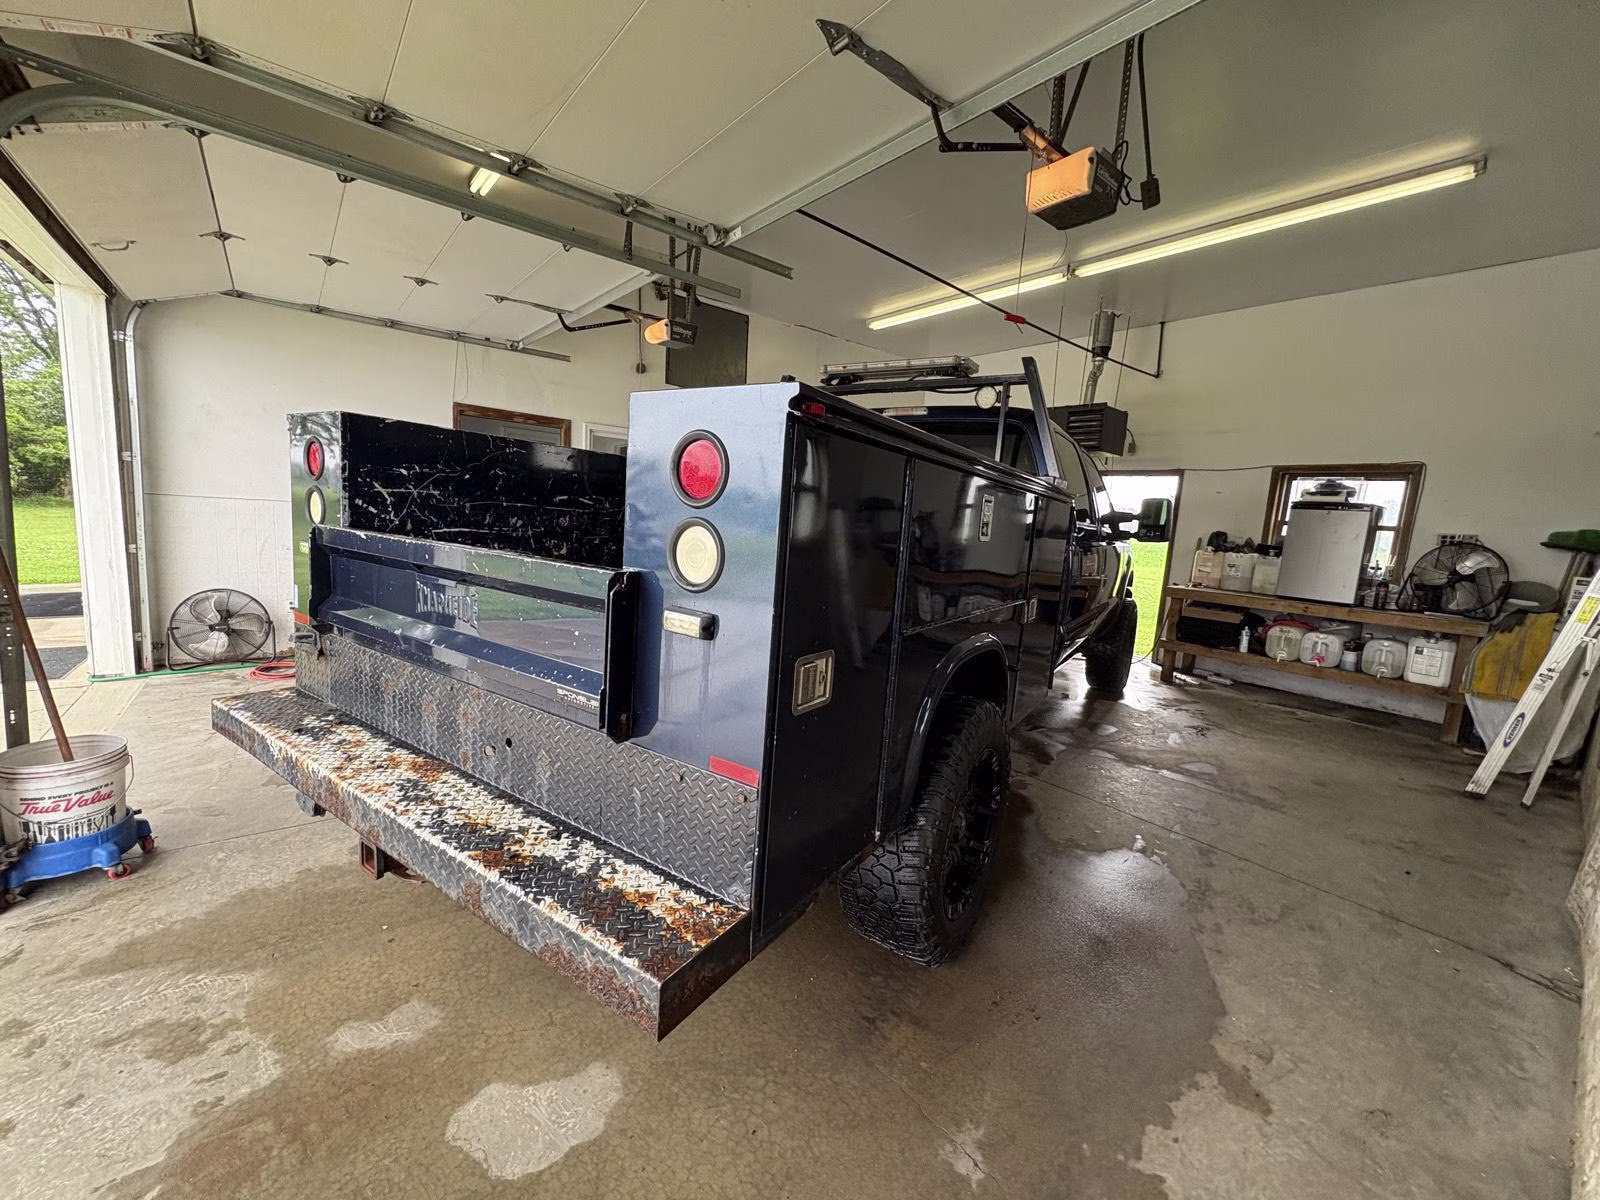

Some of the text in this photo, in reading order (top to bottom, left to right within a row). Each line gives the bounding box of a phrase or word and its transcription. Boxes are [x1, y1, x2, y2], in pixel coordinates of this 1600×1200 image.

[18, 790, 115, 816] True Value
[48, 792, 73, 800] EVERY
